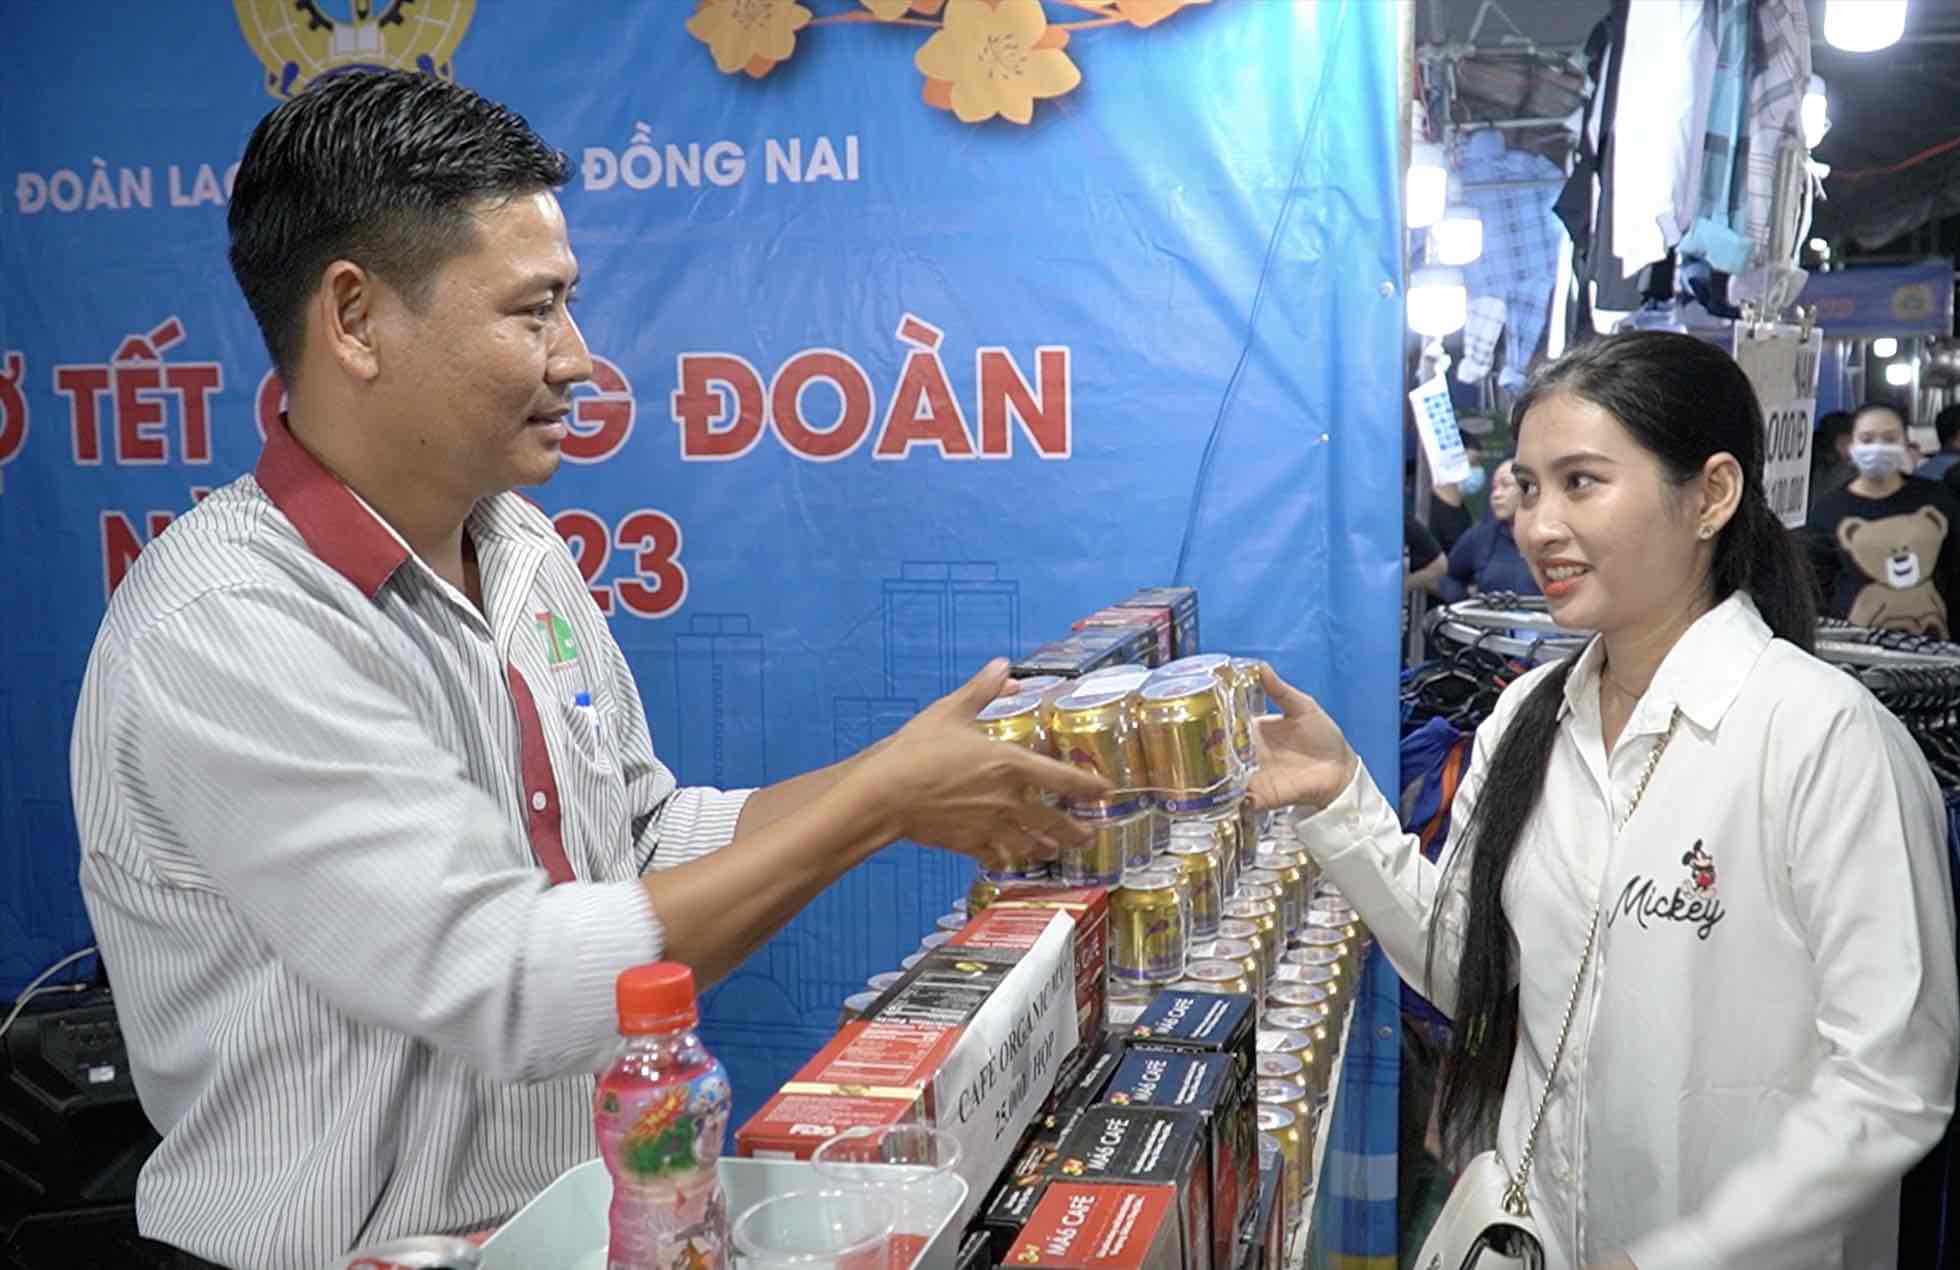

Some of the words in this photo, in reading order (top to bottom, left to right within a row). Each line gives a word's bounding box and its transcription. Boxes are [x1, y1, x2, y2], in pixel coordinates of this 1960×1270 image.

[15, 155, 153, 214] ĐOÀN
[581, 120, 747, 192] ĐỒNG
[764, 134, 860, 185] NAI
[53, 315, 223, 465] TẾT
[671, 313, 1073, 463] ĐOÀN
[1606, 876, 1726, 940] Mickey
